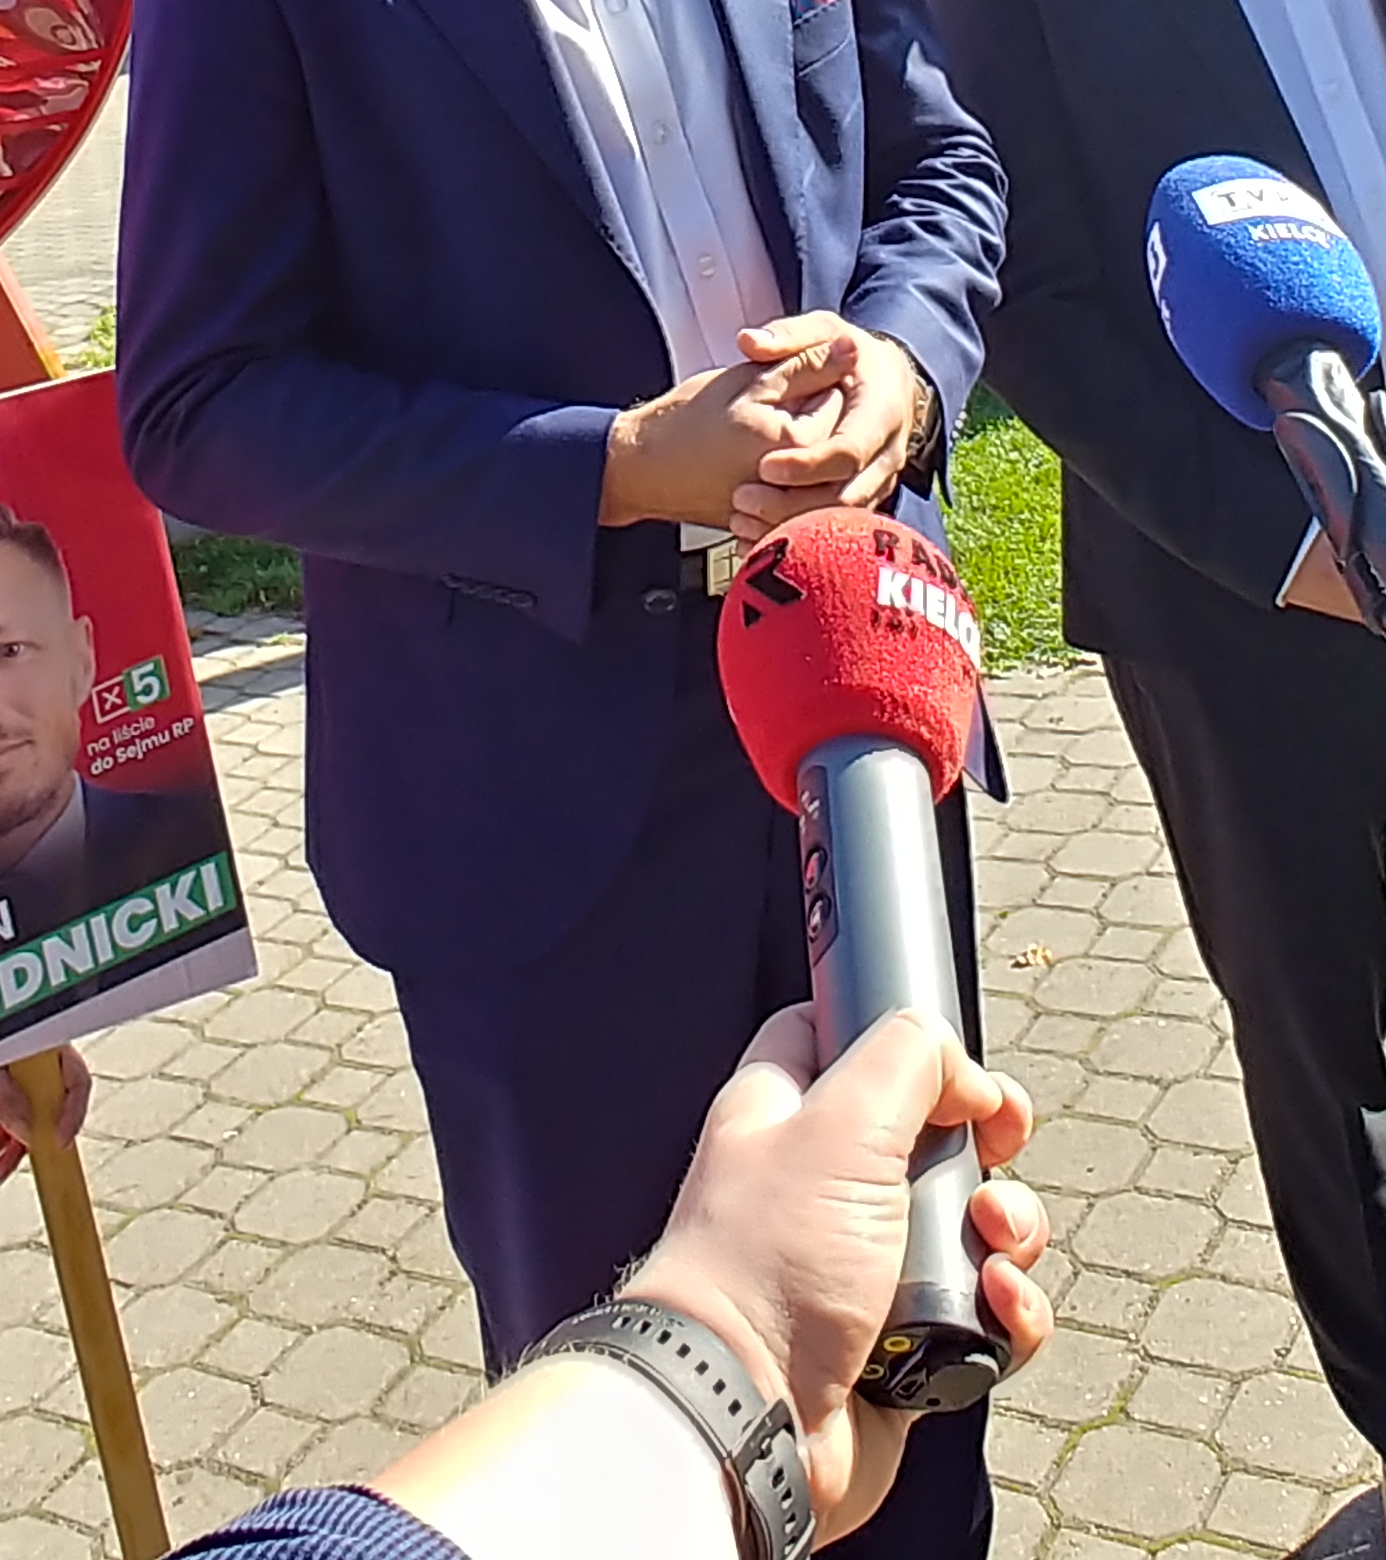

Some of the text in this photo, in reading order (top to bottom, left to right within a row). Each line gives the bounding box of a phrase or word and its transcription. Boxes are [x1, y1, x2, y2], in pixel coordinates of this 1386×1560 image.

[87, 716, 155, 757] na liście
[90, 717, 195, 775] do Sejmu RP
